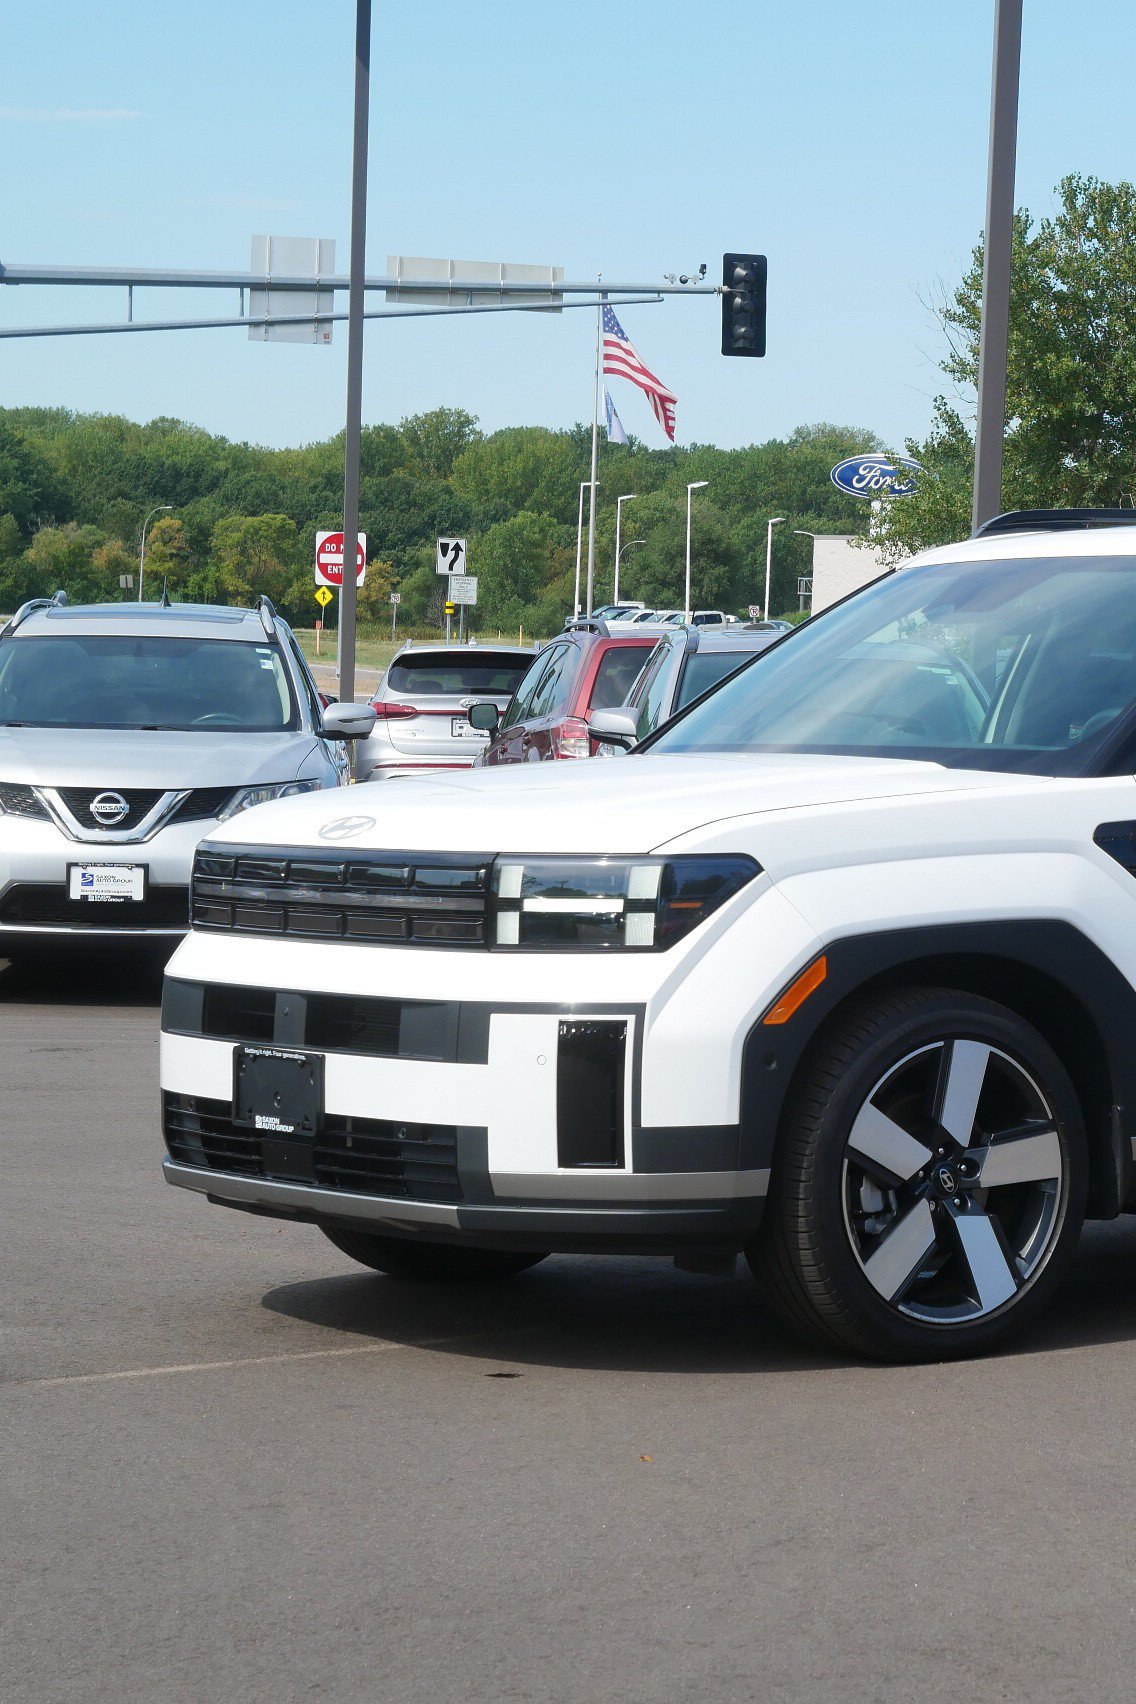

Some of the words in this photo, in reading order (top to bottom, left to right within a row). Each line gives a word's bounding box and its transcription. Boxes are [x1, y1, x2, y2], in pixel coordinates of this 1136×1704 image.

[325, 543, 337, 552] DO
[327, 565, 343, 574] ENT
[244, 1047, 260, 1056] Getting
[262, 1115, 280, 1125] SAXON
[262, 1121, 276, 1131] AUTO
[276, 1124, 295, 1133] GROUP
